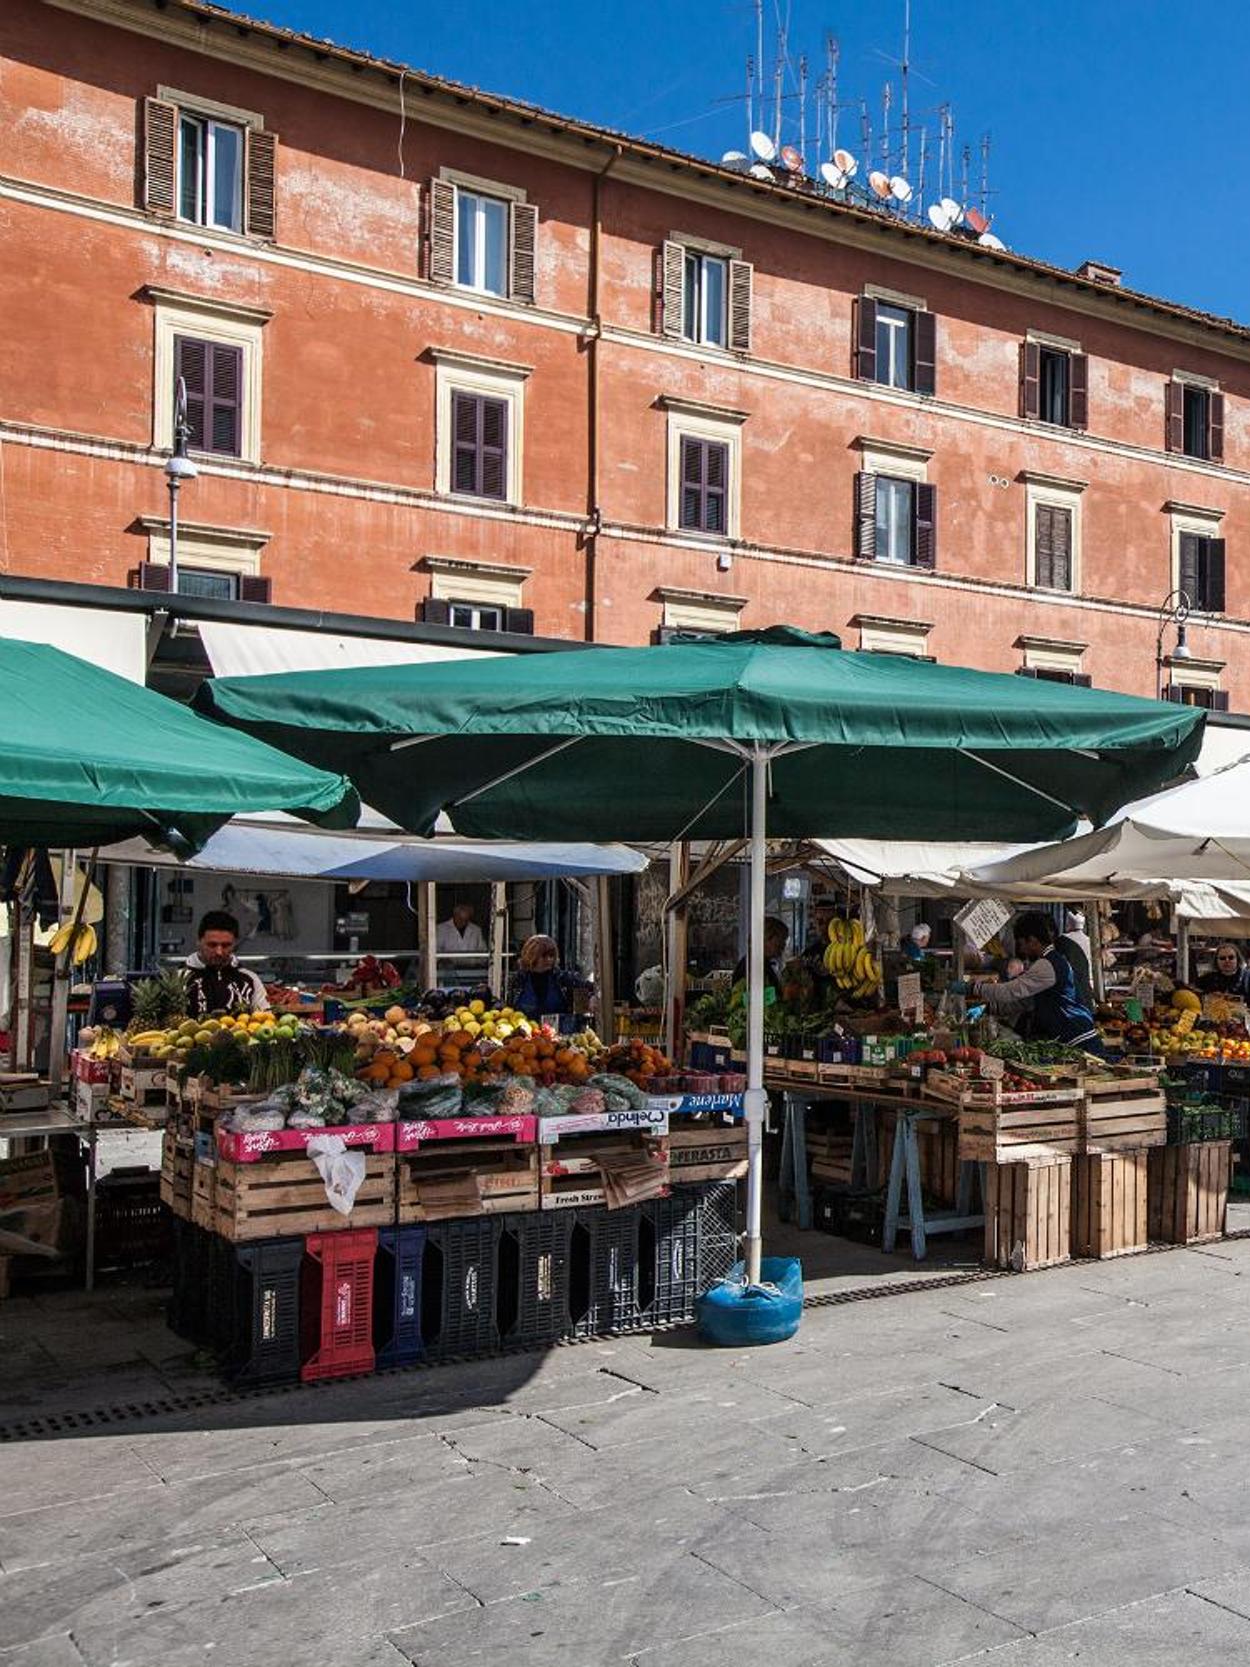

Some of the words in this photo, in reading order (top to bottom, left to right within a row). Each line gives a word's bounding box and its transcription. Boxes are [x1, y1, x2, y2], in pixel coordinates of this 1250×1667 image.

[689, 1092, 742, 1109] Marlene
[608, 1111, 664, 1126] Melinda
[556, 1194, 579, 1204] Fresh
